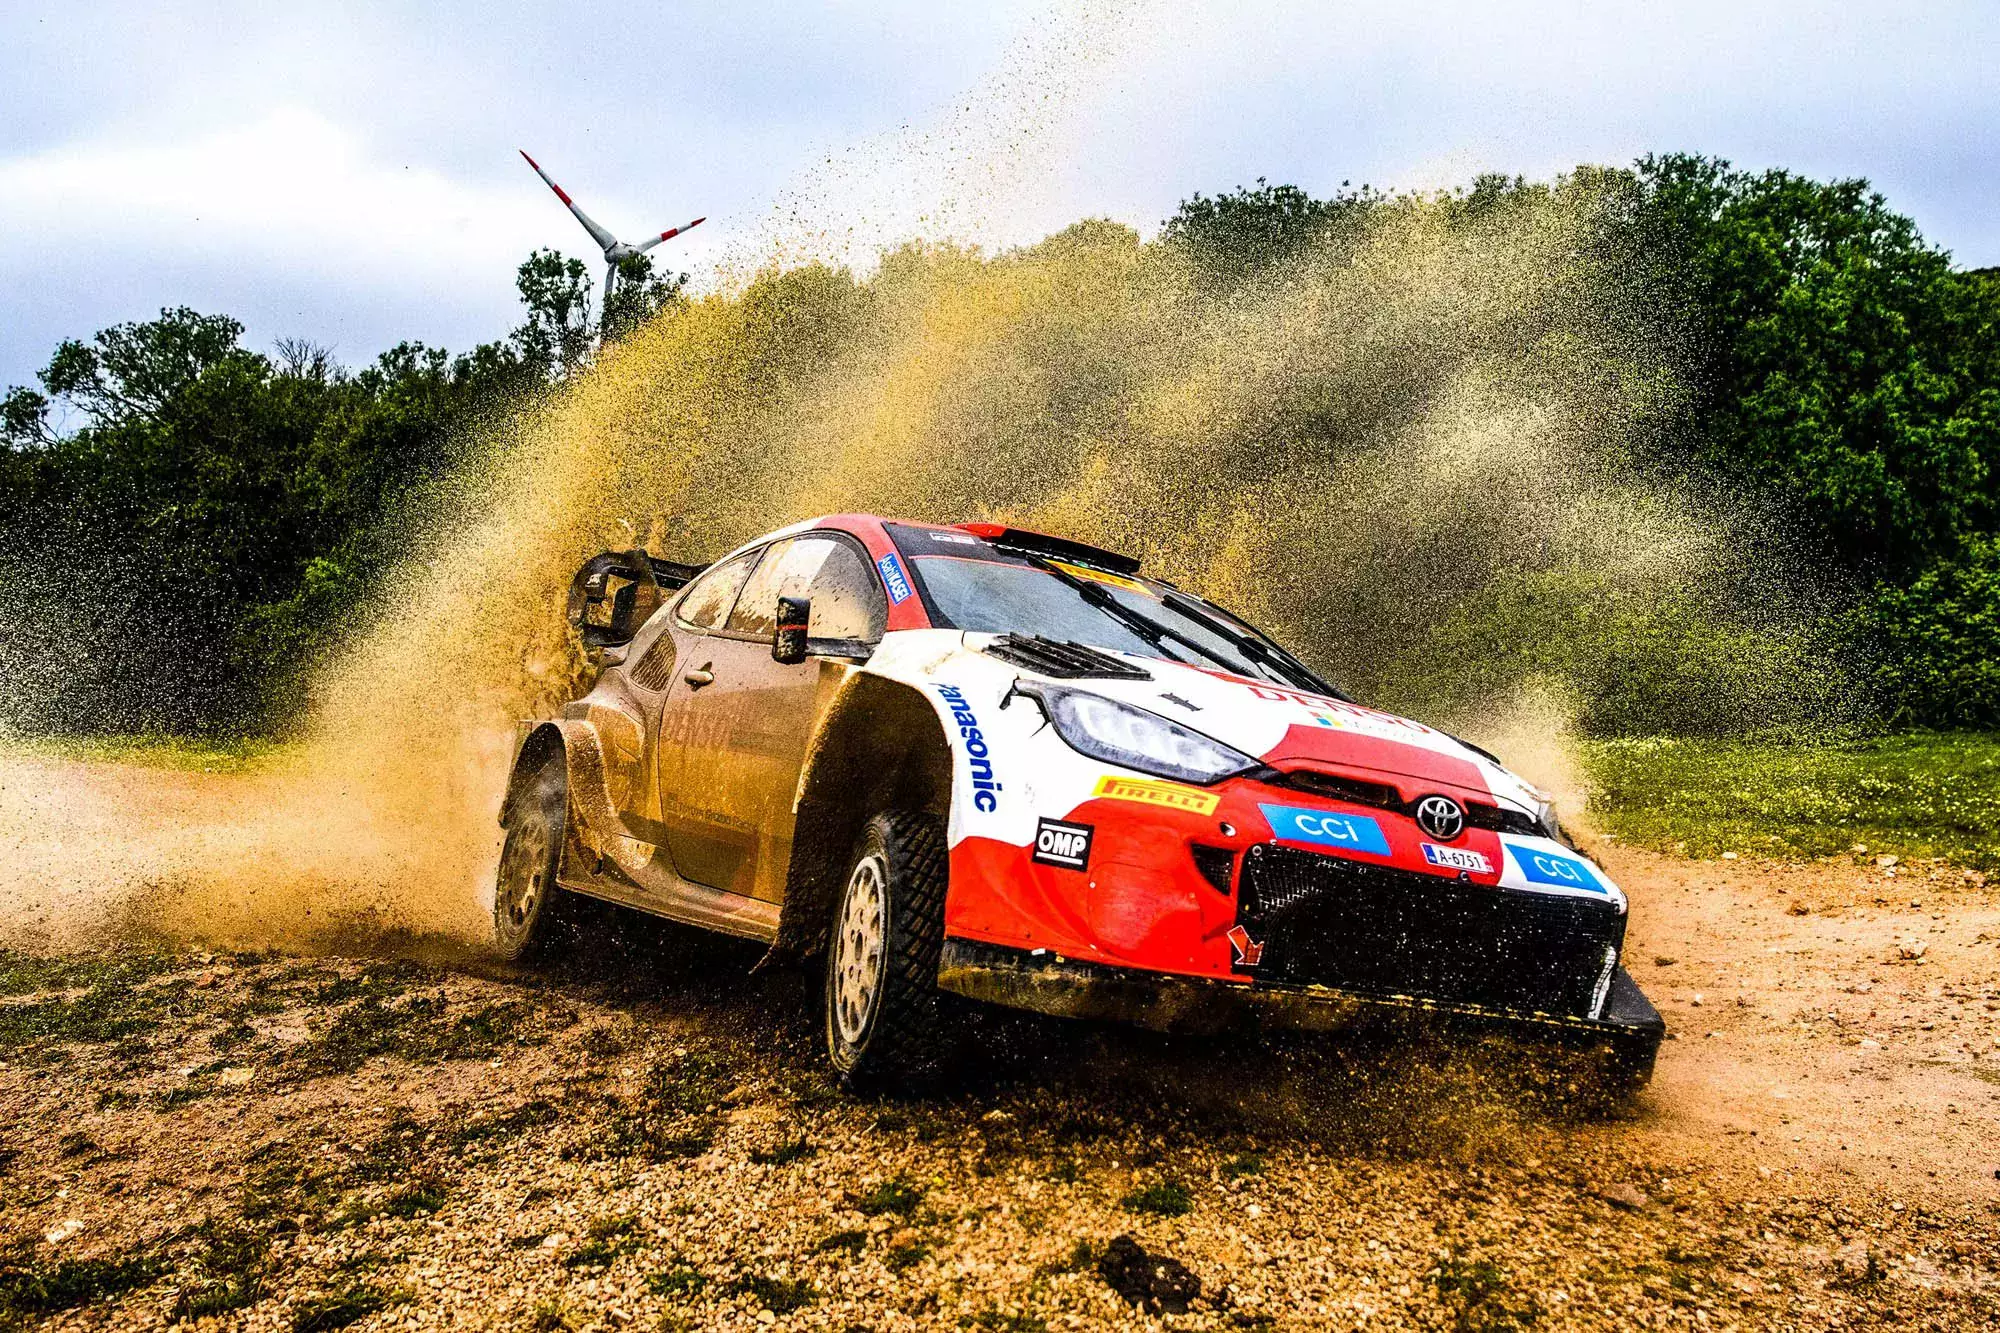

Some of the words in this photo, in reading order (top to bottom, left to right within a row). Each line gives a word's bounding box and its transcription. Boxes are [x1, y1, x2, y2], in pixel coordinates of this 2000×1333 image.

[1102, 780, 1208, 809] PIRELLI
[1038, 830, 1087, 857] OMP
[1439, 850, 1482, 869] A-6751
